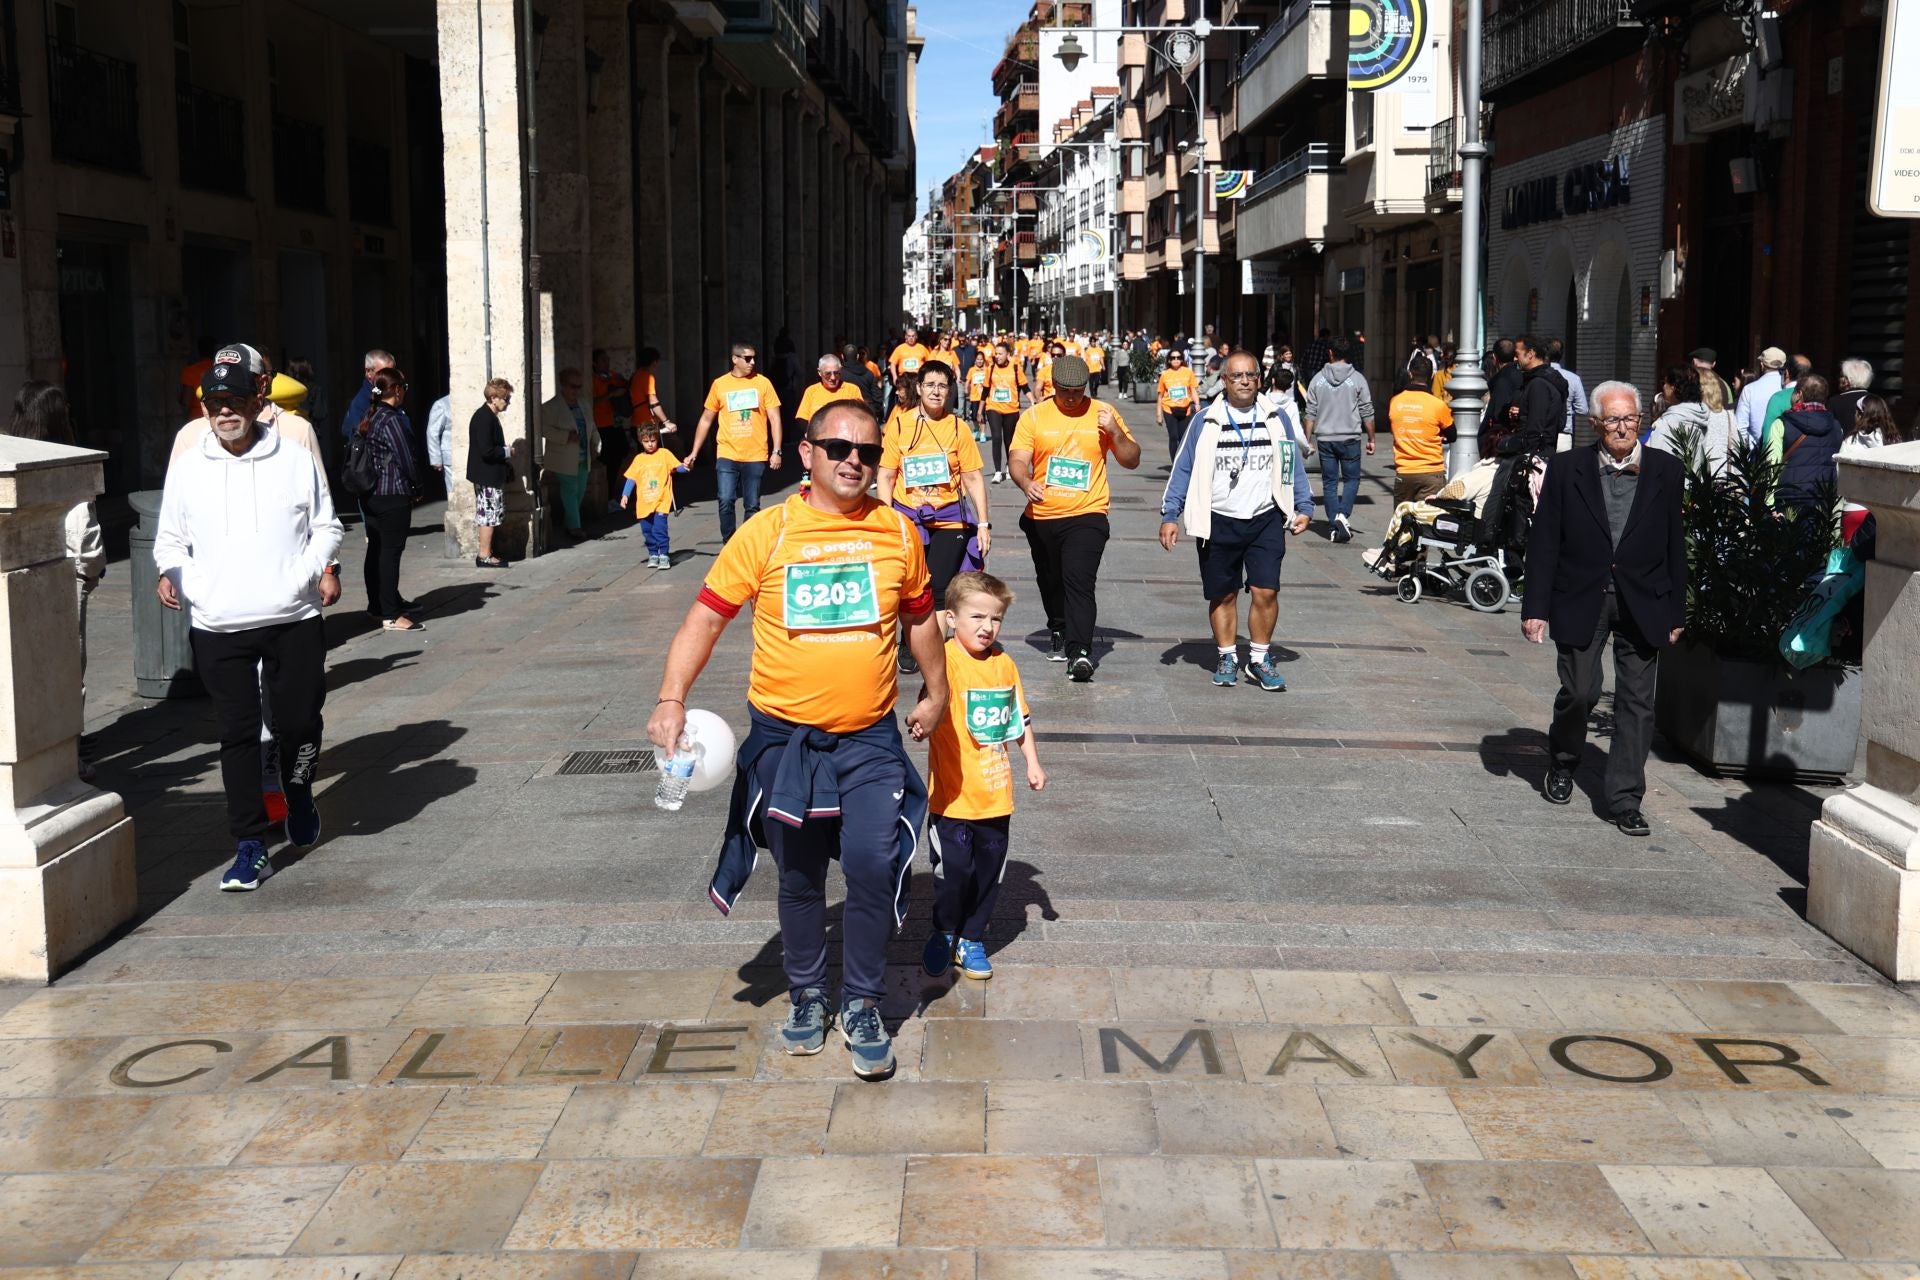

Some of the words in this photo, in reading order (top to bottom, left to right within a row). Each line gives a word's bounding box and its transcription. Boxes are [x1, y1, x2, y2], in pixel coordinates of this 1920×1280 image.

[1408, 75, 1428, 84] 1979
[1894, 169, 1920, 177] VIDEO
[62, 270, 105, 291] PTICA
[906, 461, 945, 478] 5313
[1053, 465, 1083, 480] 6334
[823, 539, 873, 553] oregón
[795, 581, 862, 607] 6203
[972, 705, 1012, 727] 620
[108, 1025, 749, 1088] CALLE
[1099, 1027, 1832, 1087] MAYOR
